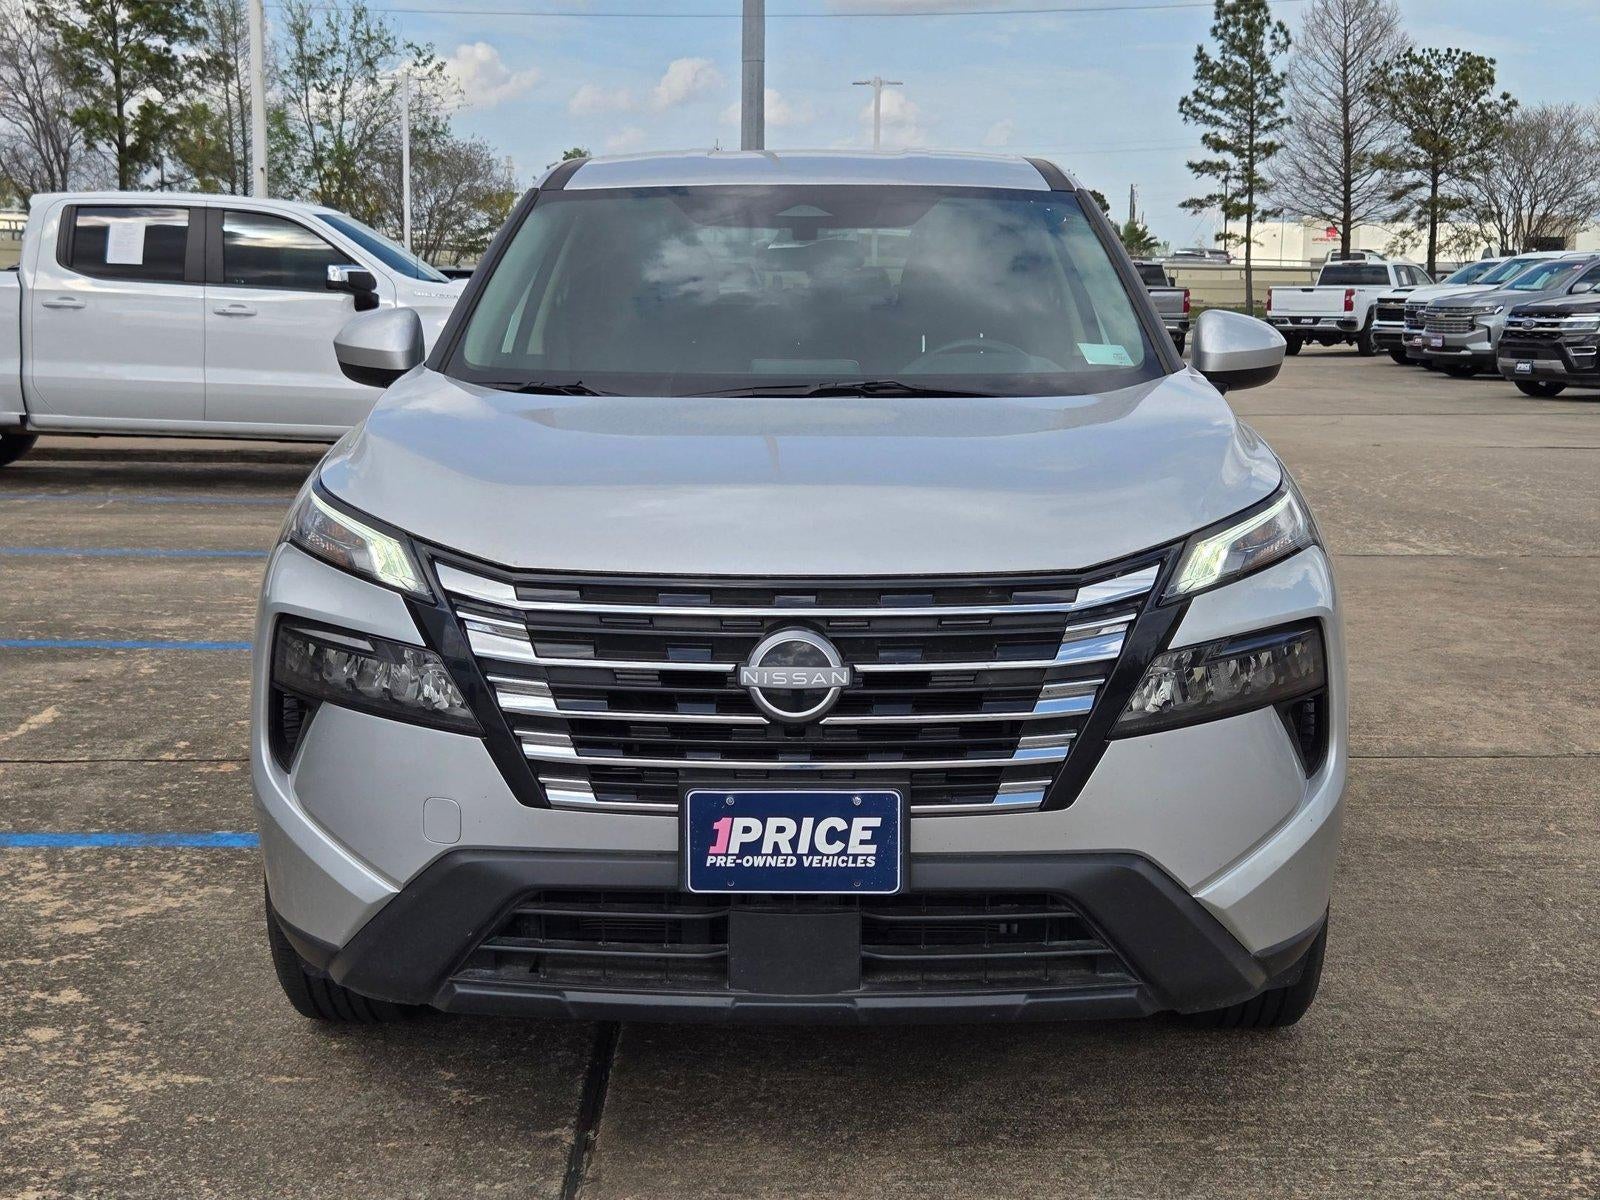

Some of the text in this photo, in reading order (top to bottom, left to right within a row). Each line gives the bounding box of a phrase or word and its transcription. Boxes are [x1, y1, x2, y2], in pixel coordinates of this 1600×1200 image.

[743, 671, 847, 685] NISSAN
[709, 817, 882, 854] 1PRICE
[706, 855, 876, 868] PRE-OWNED VEHICLES
